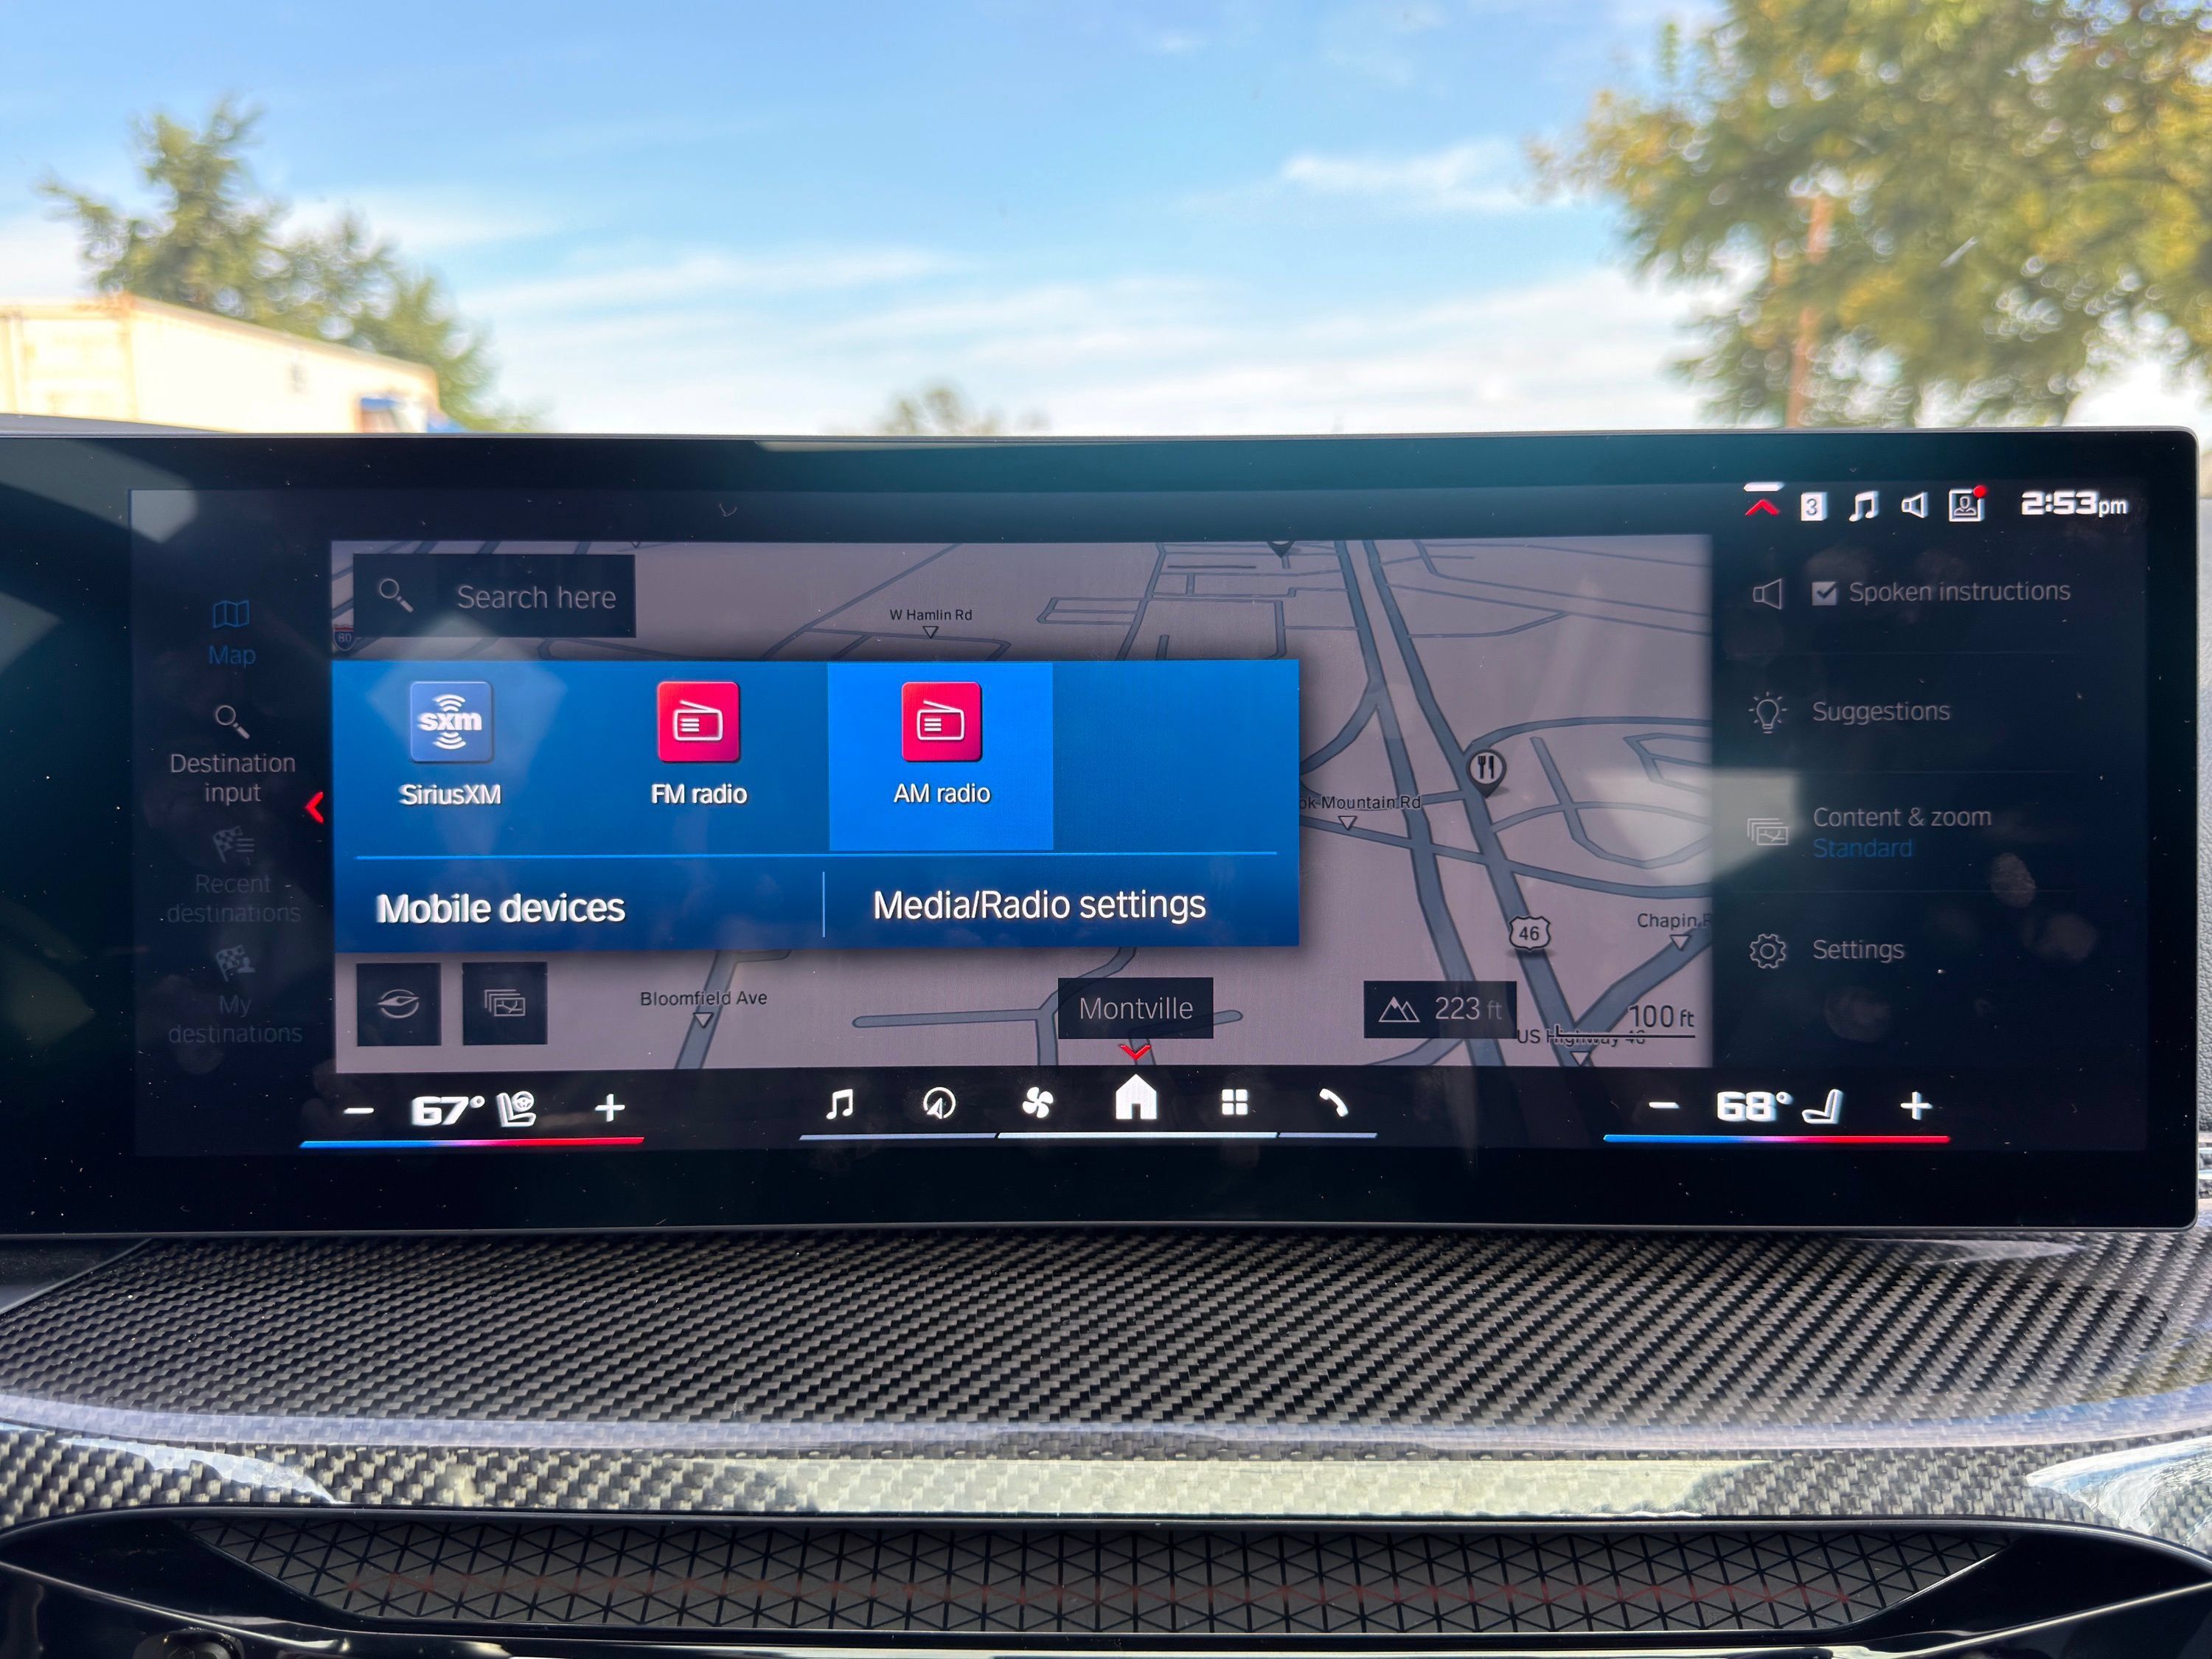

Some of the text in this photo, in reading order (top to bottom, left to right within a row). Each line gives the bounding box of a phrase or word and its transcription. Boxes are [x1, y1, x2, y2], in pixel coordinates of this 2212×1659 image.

[1806, 498, 1818, 516] 3
[457, 583, 617, 611] Search here
[1849, 580, 2071, 603] Spoken instructions
[889, 608, 973, 620] W Hamlin Rd
[208, 644, 257, 667] Map
[418, 709, 483, 732] sxm
[1812, 701, 1950, 726] Suggestions
[170, 752, 296, 775] Destination
[204, 783, 262, 806] input
[399, 784, 501, 805] SiriusXM
[651, 783, 748, 805] FM radio
[893, 783, 991, 804] AM radio
[1321, 796, 1395, 809] Mountain
[1401, 796, 1421, 809] Rd
[1813, 807, 1992, 827] Content & zoom
[1813, 838, 1913, 858] Standard
[195, 874, 271, 894] Recent
[167, 903, 302, 923] destinations
[376, 892, 627, 924] Mobile devices
[874, 890, 1207, 925] Media/Radio settings
[1638, 913, 1697, 930] Chapin
[1519, 926, 1540, 942] 46
[1813, 940, 1905, 963] Settings
[220, 995, 252, 1018] My
[640, 990, 768, 1006] Bloomfield Ave
[1079, 997, 1194, 1020] Montville
[1435, 998, 1503, 1020] 223 ft
[1629, 1005, 1694, 1027] 100 ft
[168, 1024, 304, 1043] destinations
[1517, 1029, 1540, 1044] US
